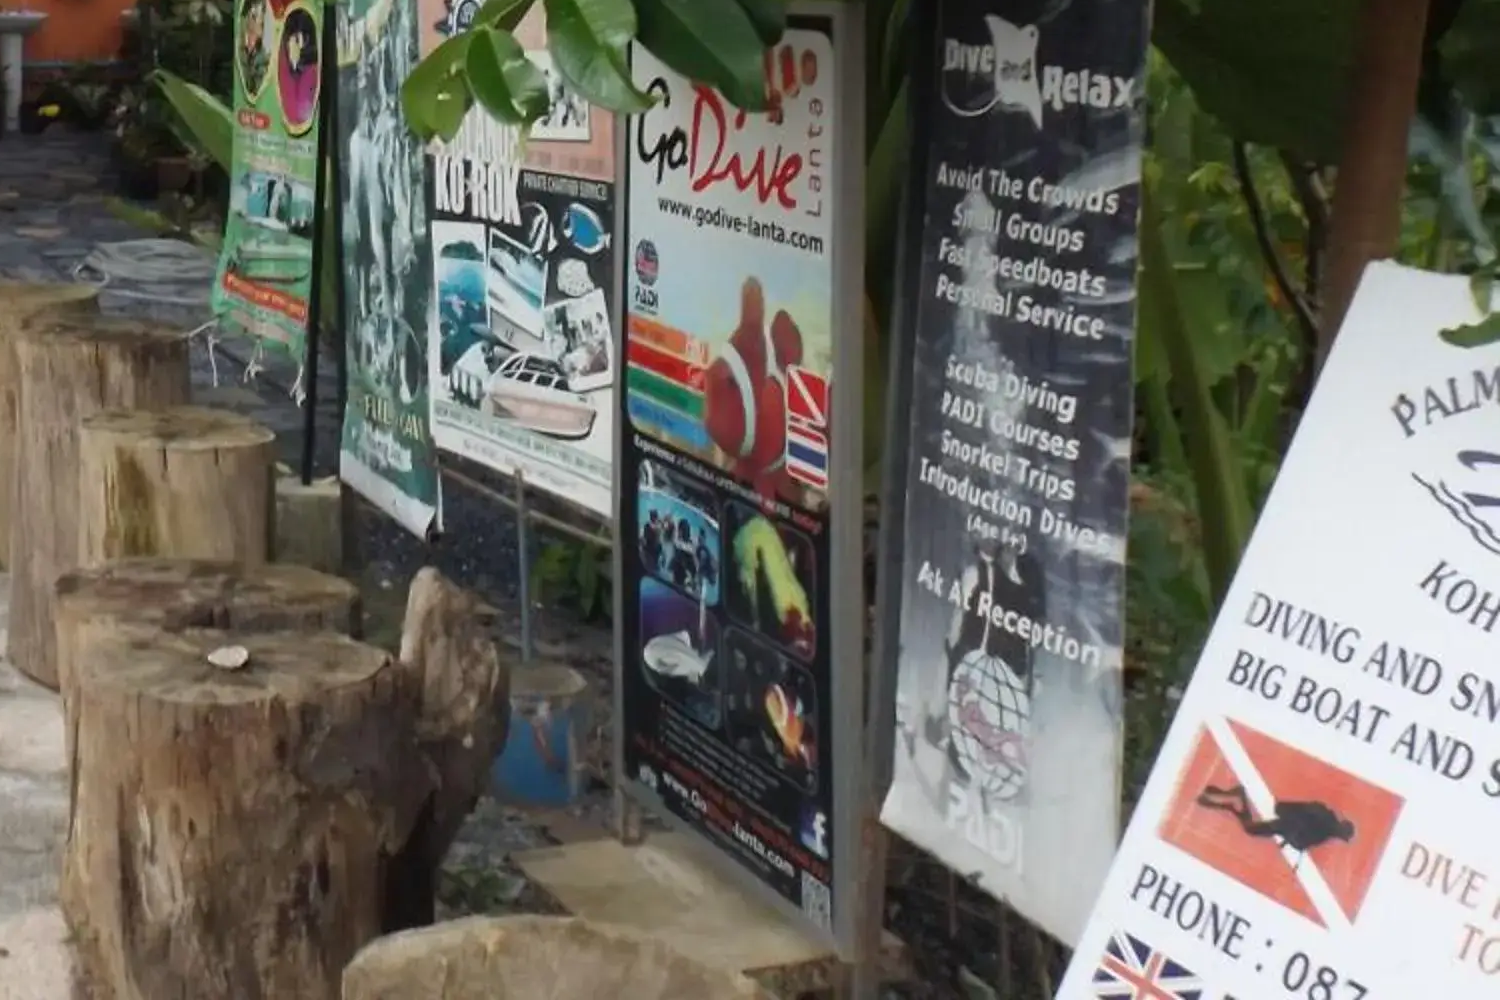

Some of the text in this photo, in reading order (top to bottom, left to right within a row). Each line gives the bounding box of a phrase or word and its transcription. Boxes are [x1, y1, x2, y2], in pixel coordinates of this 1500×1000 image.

[942, 38, 996, 74] Dive
[1043, 65, 1136, 112] Relax
[657, 196, 824, 255] www.godive-lanta.com
[936, 161, 1122, 216] Avoid The Crowds
[951, 202, 1086, 255] Small Groups
[934, 273, 1106, 341] Personal Service
[940, 390, 1081, 462] PADI Courses
[945, 354, 1078, 424] Scuba Diving
[940, 428, 1077, 502] Snorkel Trips
[919, 457, 1111, 554] Introduction Dives
[916, 560, 1102, 667] Ask At Reception
[1417, 559, 1500, 633] KOH
[1244, 590, 1362, 664] DIVING
[1361, 640, 1443, 697] AND
[1226, 648, 1288, 701] BIG
[1288, 675, 1391, 744] BOAT
[1390, 721, 1475, 782] AND
[1129, 863, 1252, 960] PHONE
[1400, 841, 1488, 911] DIVE
